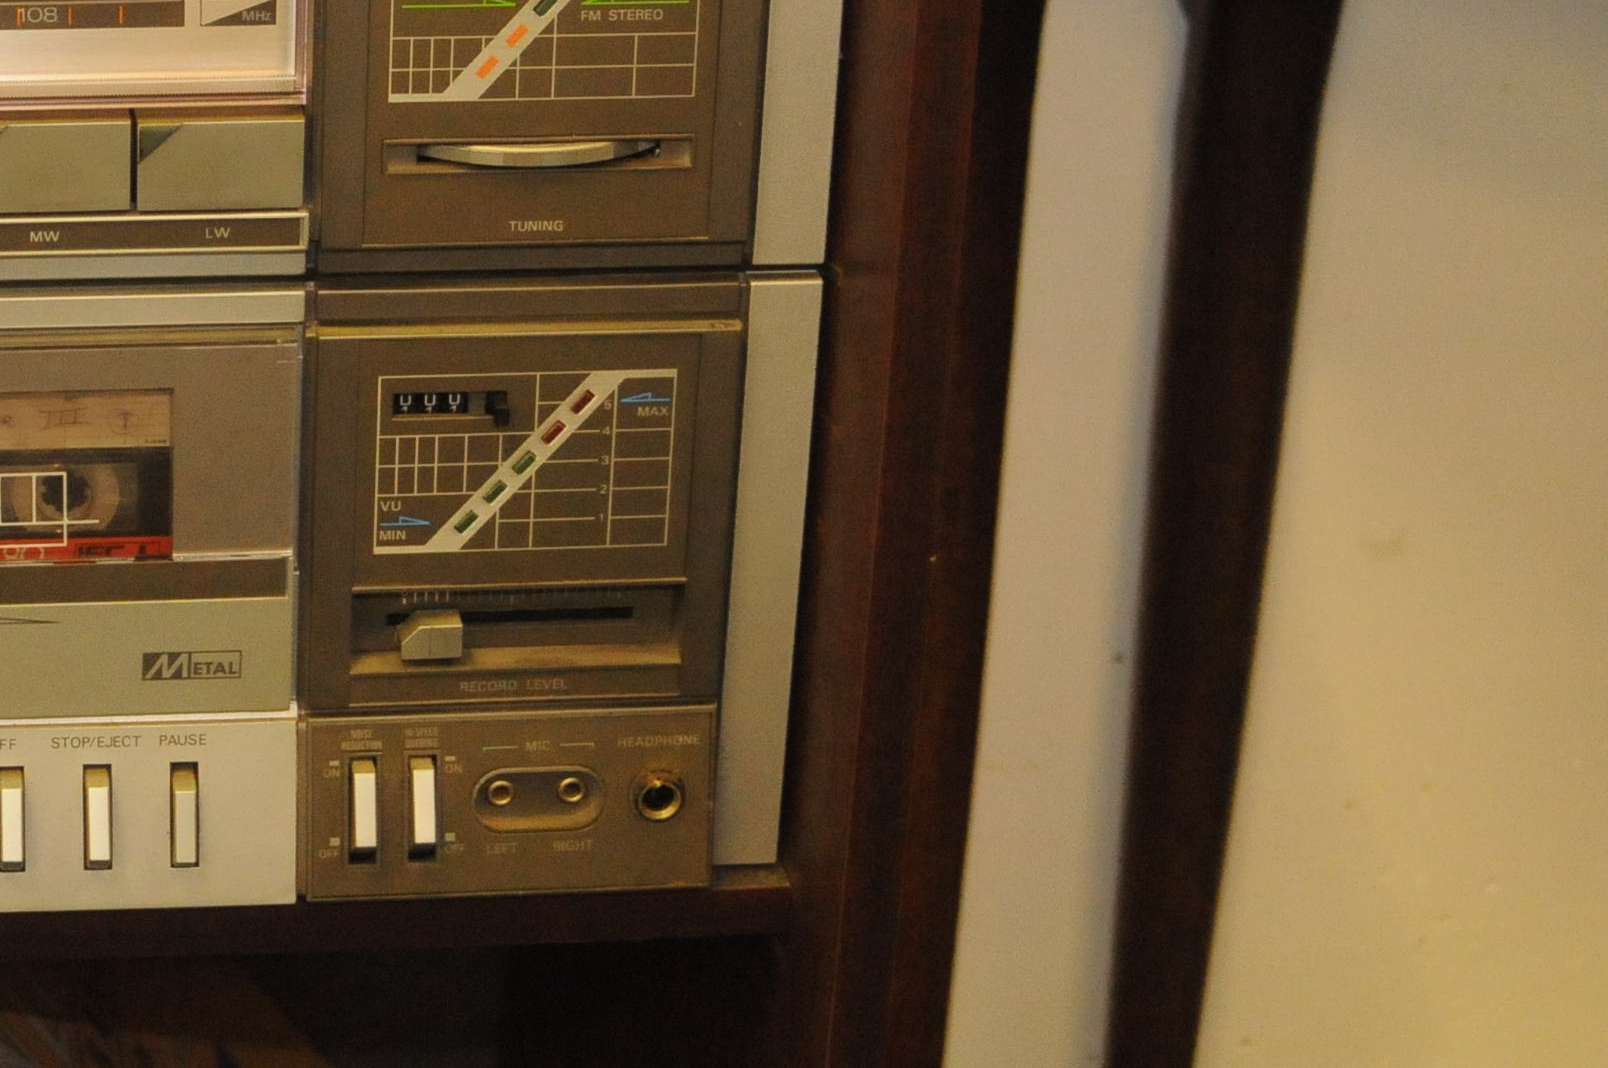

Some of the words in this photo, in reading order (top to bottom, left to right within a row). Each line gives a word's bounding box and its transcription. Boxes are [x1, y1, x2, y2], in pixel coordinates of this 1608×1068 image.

[19, 6, 58, 22] 108
[242, 11, 272, 21] MHz
[580, 9, 602, 22] FM
[608, 8, 664, 21] STEREO
[205, 226, 231, 240] LW
[509, 219, 564, 233] TUNING
[29, 230, 60, 244] MW
[637, 406, 669, 417] MAX
[601, 455, 609, 466] 3
[599, 485, 608, 495] 2
[380, 500, 401, 512] VU
[379, 530, 406, 541] MIN
[144, 650, 242, 680] METAL
[460, 680, 517, 693] RECORD
[526, 679, 567, 691] LEVEL
[0, 737, 17, 750] FF
[50, 734, 141, 750] STOP/EJECT
[158, 732, 207, 747] PAUSE
[618, 735, 700, 748] HEADPHONE
